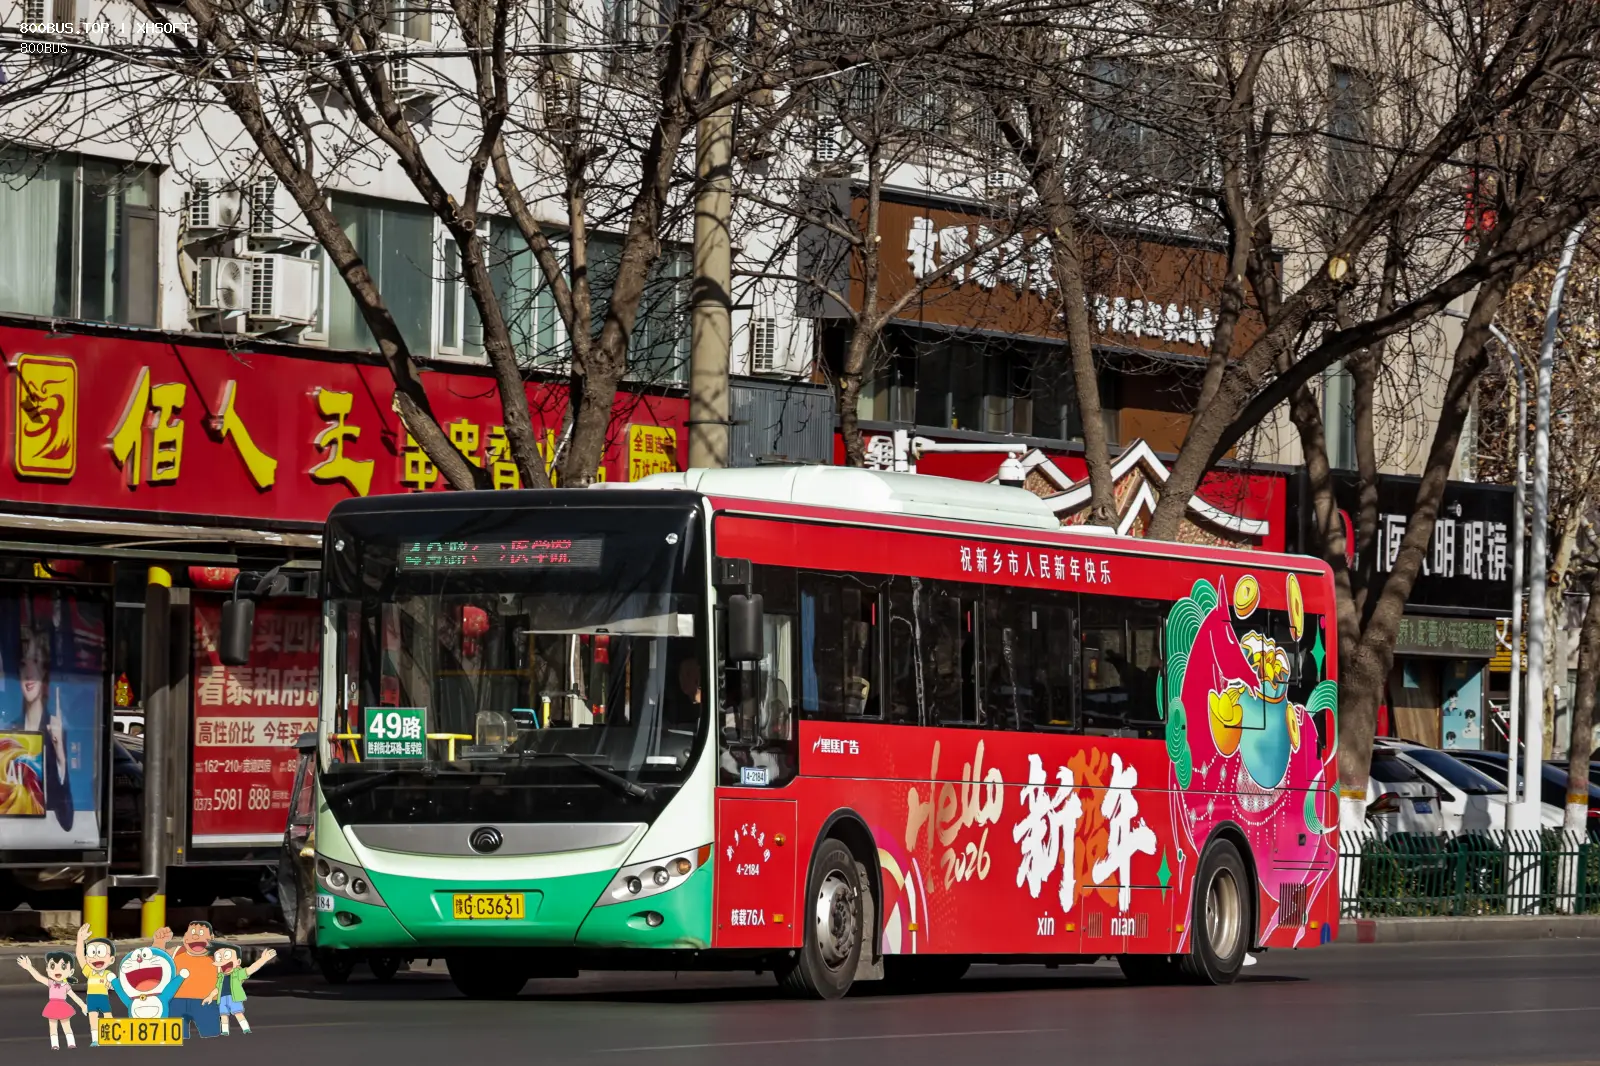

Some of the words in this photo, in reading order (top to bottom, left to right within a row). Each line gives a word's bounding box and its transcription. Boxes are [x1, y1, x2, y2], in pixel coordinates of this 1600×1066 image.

[960, 545, 1112, 585] 祝新乡市人民新年快乐
[198, 721, 255, 744] 高性价比
[369, 712, 422, 739] 49路
[213, 788, 243, 811] 5981
[248, 788, 271, 811] 888
[905, 739, 1004, 894] Hello
[1012, 752, 1157, 914] 新年
[736, 863, 760, 876] 4-2184
[940, 829, 991, 891] 2026
[316, 896, 331, 910] 184
[731, 909, 766, 926] 核载76人
[1036, 912, 1055, 936] xin
[1110, 912, 1136, 937] nian
